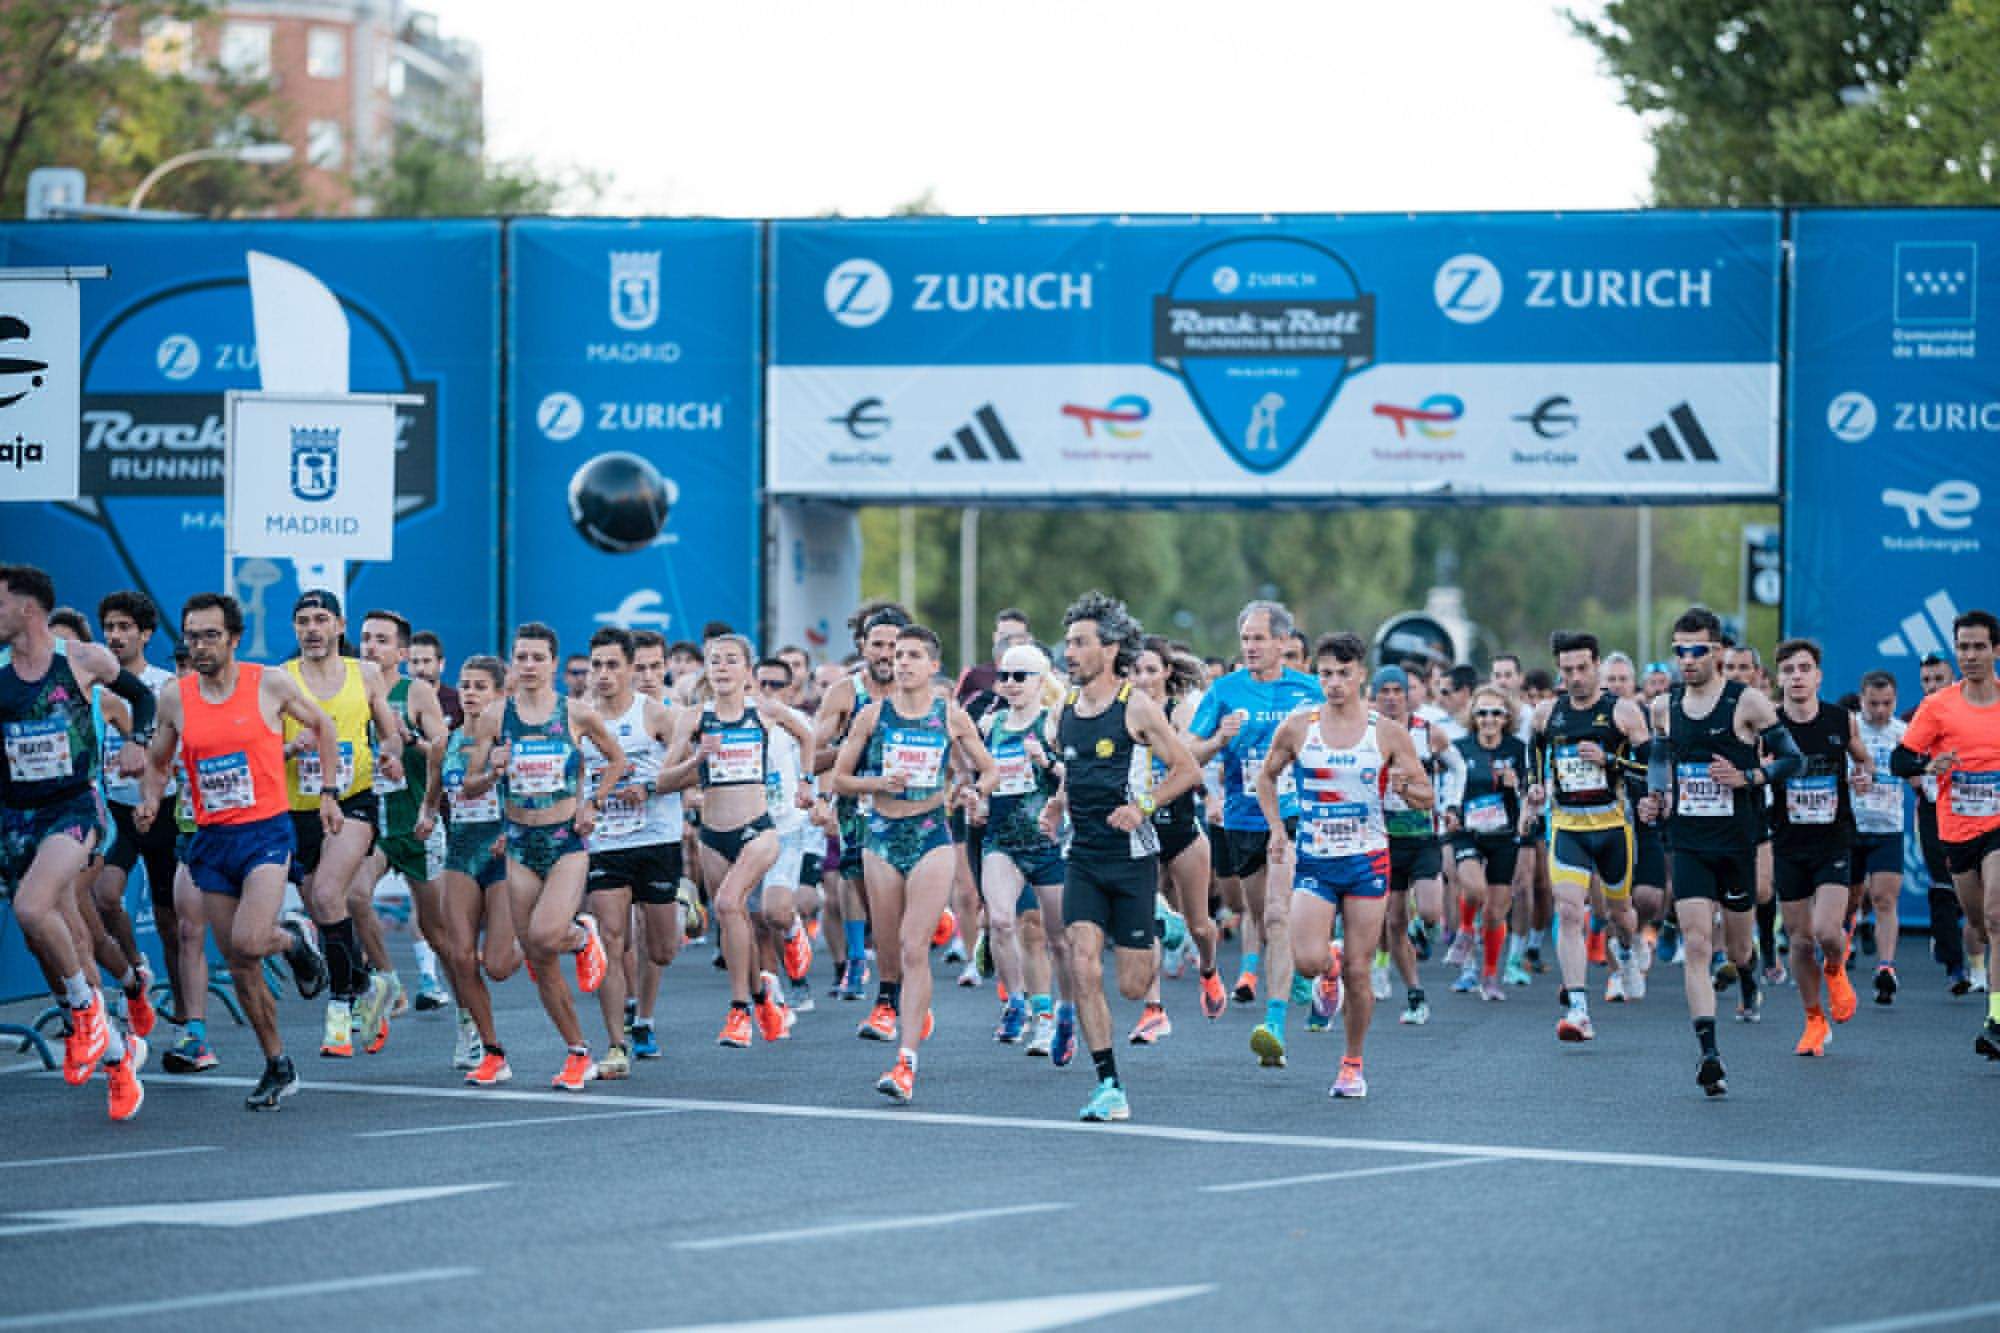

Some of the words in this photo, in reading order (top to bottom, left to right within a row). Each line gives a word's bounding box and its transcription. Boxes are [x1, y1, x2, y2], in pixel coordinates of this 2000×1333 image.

[911, 272, 1093, 312] ZURICH
[1524, 268, 1713, 308] ZURICH
[1168, 308, 1260, 335] Rock
[586, 342, 682, 364] MADRID
[1184, 335, 1272, 350] RUNNING
[1273, 335, 1343, 350] SERIES
[81, 410, 225, 450] Rock
[597, 401, 723, 431] ZURICH
[1892, 401, 2000, 432] ZURIC
[264, 514, 361, 536] MADRID
